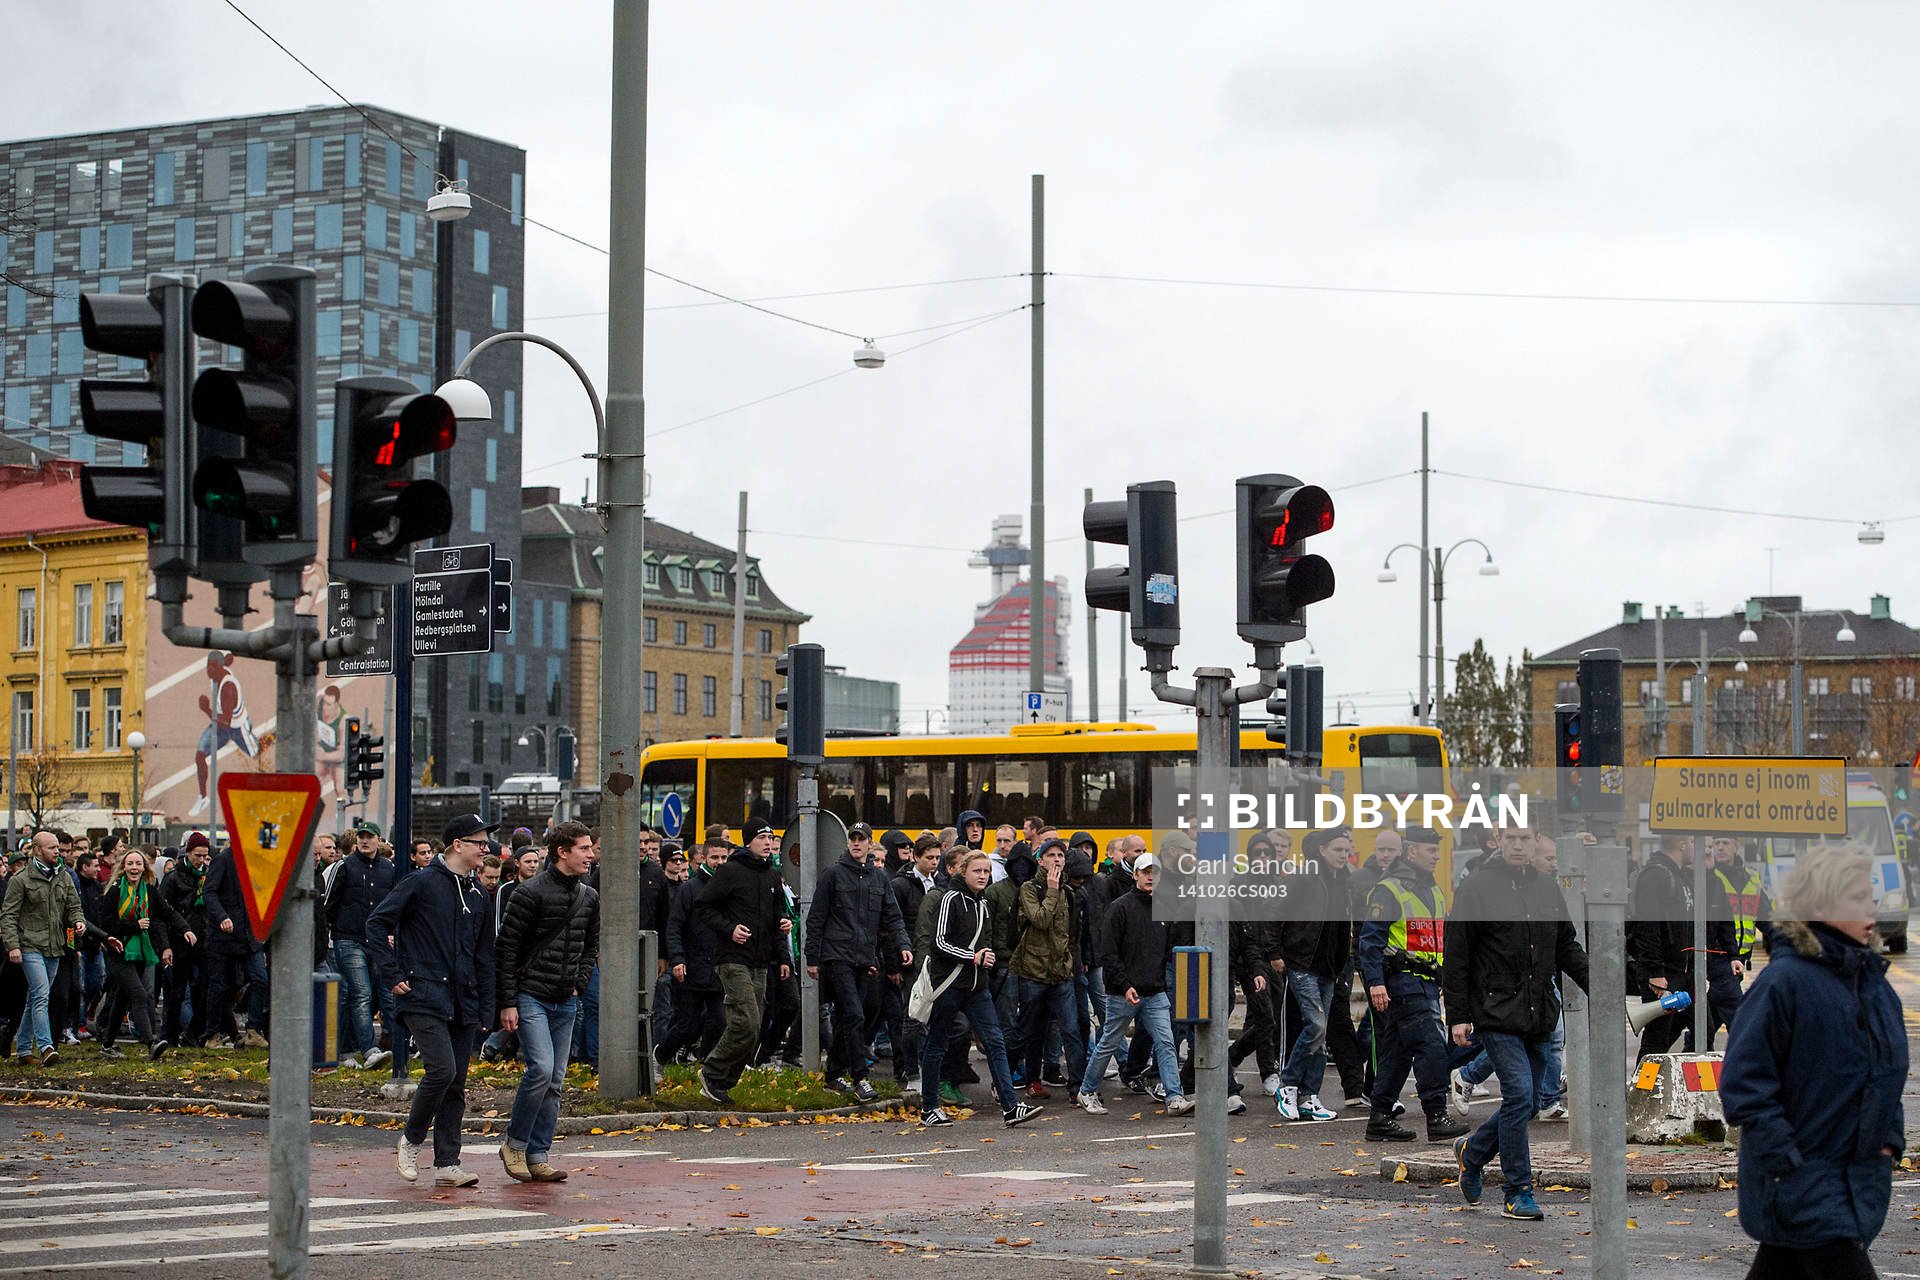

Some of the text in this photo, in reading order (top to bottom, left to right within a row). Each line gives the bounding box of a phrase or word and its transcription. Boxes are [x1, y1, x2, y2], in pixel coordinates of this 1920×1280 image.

[415, 581, 441, 592] Partille
[415, 594, 444, 606] Mölndal
[415, 608, 464, 622] Gamlestaden
[415, 623, 477, 637] Redbergsplatsen
[415, 639, 437, 651] Ullevi
[339, 658, 390, 671] Centralstation
[1679, 767, 1811, 793] Stanna ej inom
[1655, 798, 1839, 823] gulmarkerat område
